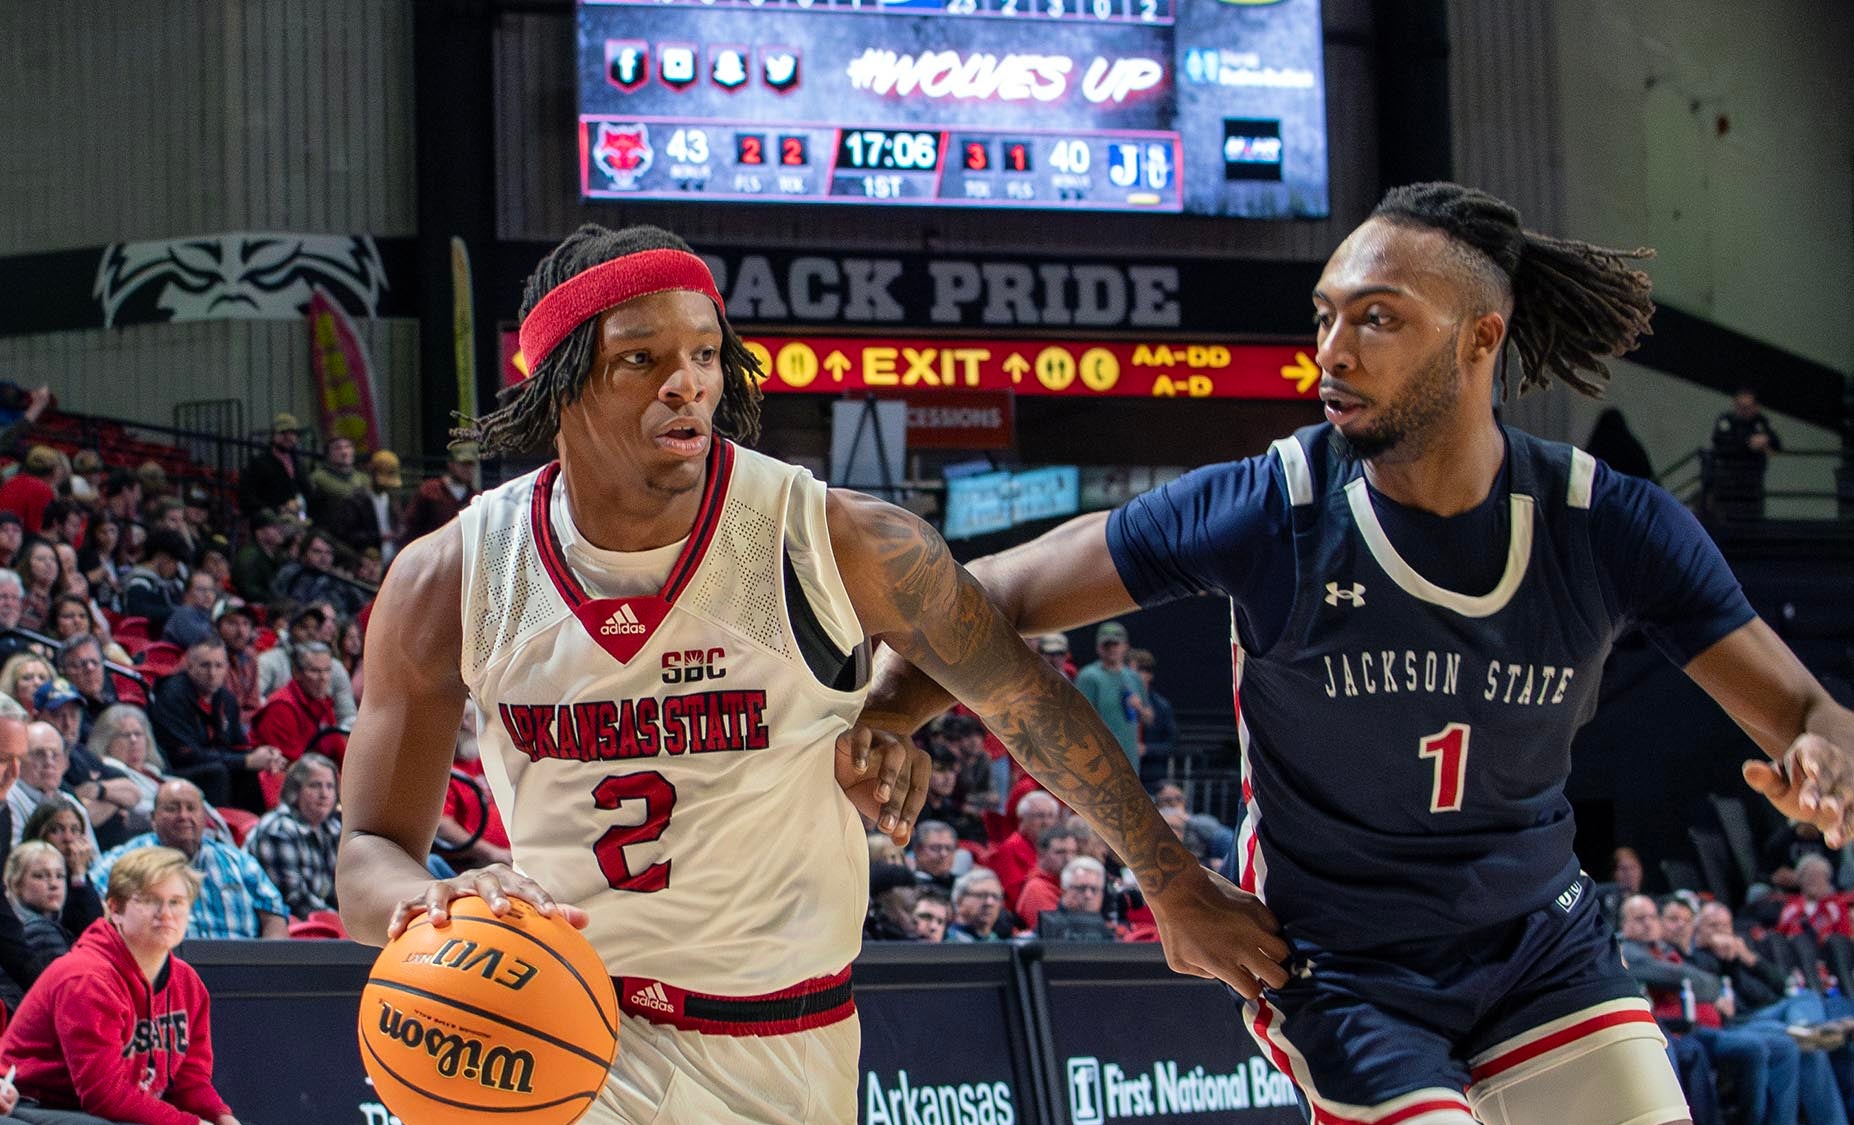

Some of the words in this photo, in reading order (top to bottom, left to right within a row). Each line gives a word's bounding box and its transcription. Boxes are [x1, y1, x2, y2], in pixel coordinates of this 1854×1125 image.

[1082, 57, 1163, 103] UP
[666, 130, 709, 164] 43
[741, 138, 762, 165] 2
[782, 138, 802, 165] 2
[845, 131, 937, 168] 17:06
[966, 142, 987, 170] 3
[1009, 144, 1025, 171] 1
[1049, 140, 1090, 173] 40
[863, 176, 903, 198] 1ST
[929, 260, 1182, 327] PRIDE
[862, 347, 991, 387] EXIT
[1131, 343, 1232, 369] AA-DD
[1151, 374, 1214, 397] A-D
[600, 621, 646, 635] adidas
[661, 647, 727, 684] SBC
[1323, 650, 1461, 698] JACKSON
[1483, 659, 1575, 706] STATE
[661, 689, 770, 755] STATE
[1418, 722, 1471, 814] 1
[591, 770, 678, 894] 2
[432, 938, 540, 991] EVO
[631, 994, 675, 1013] adidas
[378, 1000, 536, 1095] Wilson
[1103, 1062, 1156, 1119] First
[1153, 1059, 1251, 1115] National
[1249, 1055, 1299, 1108] Ban
